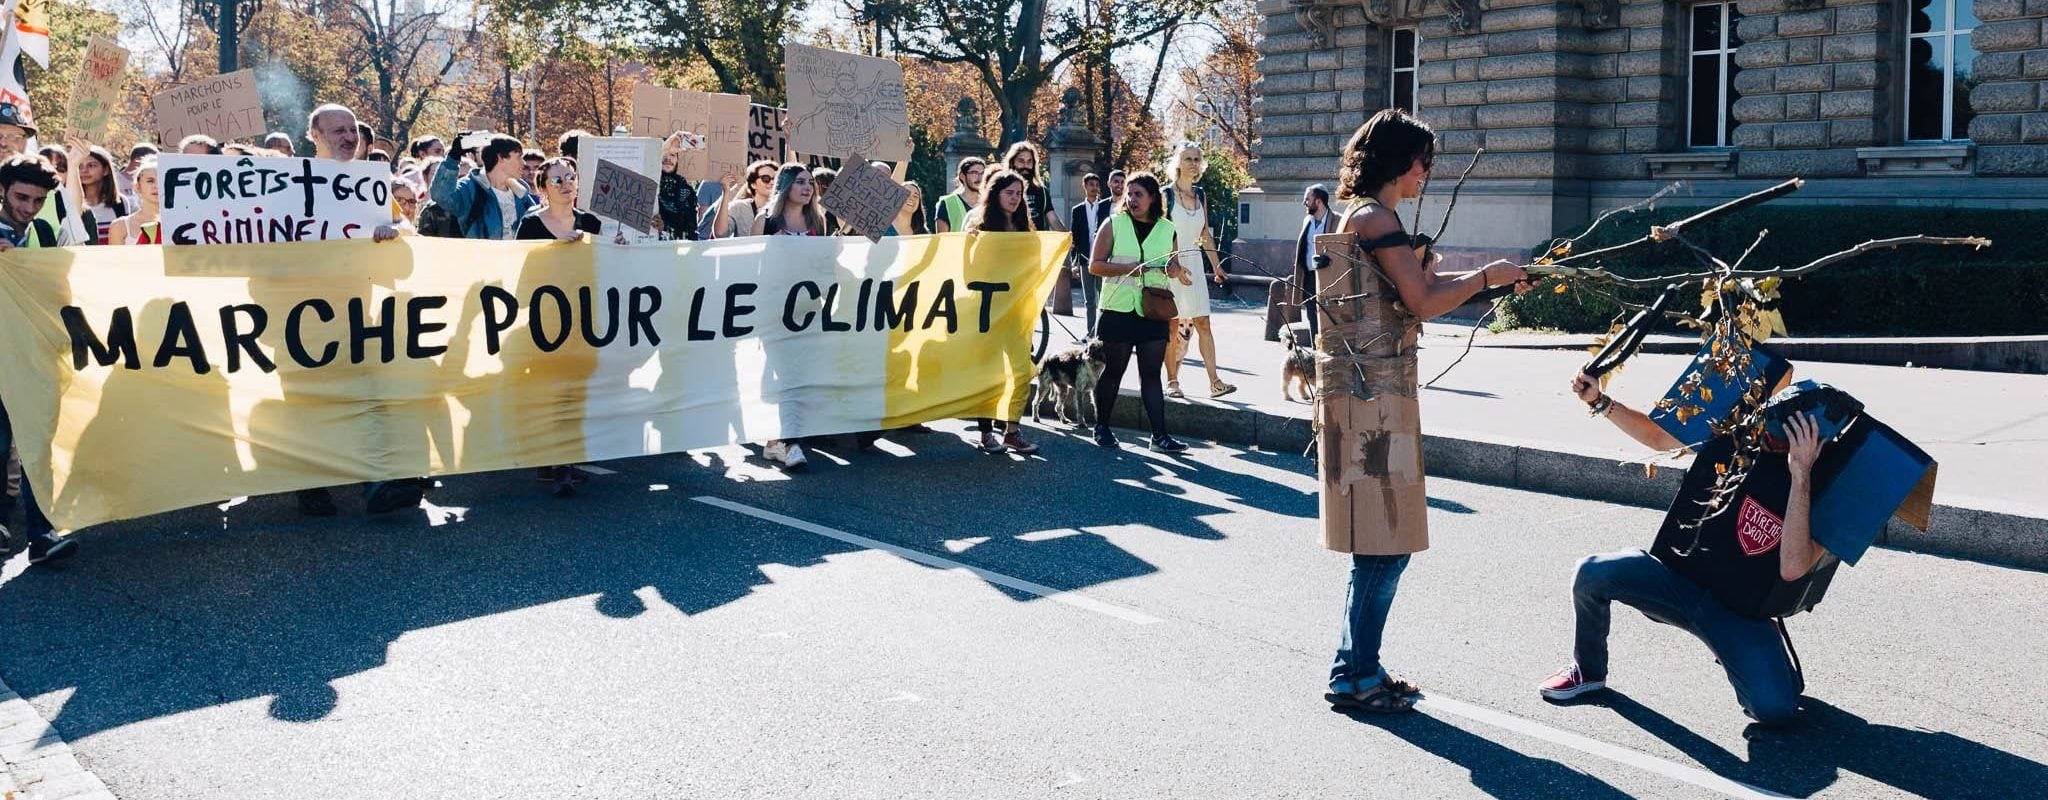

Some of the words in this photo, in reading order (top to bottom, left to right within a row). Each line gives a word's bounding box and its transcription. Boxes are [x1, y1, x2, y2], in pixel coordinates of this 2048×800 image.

[170, 78, 242, 107] MARCHONS
[187, 102, 209, 116] POUR
[212, 98, 222, 109] LE
[165, 106, 257, 148] CLIMAT
[164, 157, 290, 209] FORÊTS
[332, 173, 388, 206] GCO
[829, 182, 844, 200] IL
[846, 195, 868, 214] EST
[61, 296, 448, 374] MARCHE
[480, 286, 662, 356] POUR
[687, 283, 758, 341] LE
[781, 279, 1011, 333] CLIMAT
[1742, 521, 1771, 546] DROIT
[1745, 505, 1782, 538] EXTREME
